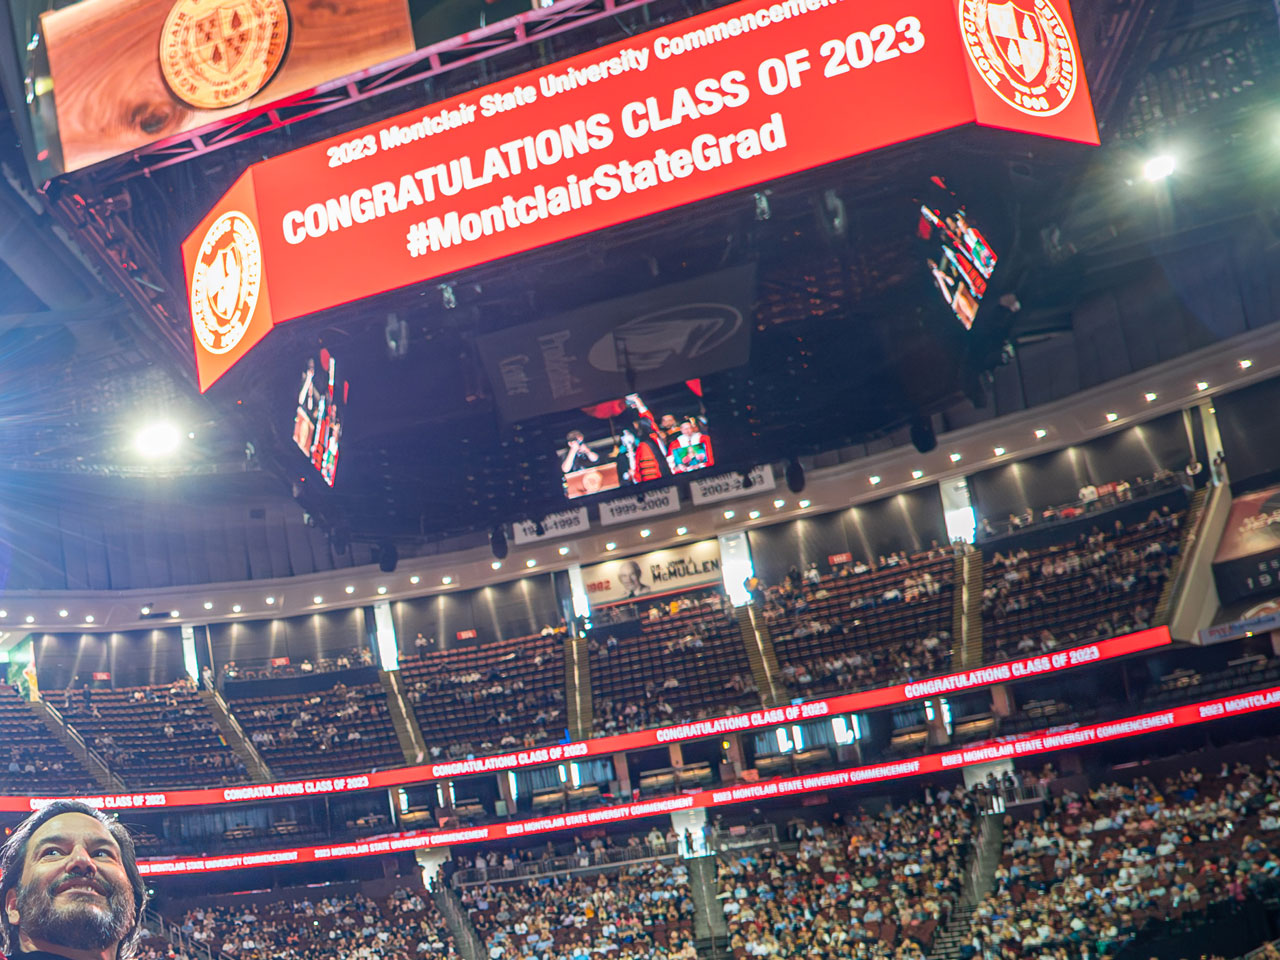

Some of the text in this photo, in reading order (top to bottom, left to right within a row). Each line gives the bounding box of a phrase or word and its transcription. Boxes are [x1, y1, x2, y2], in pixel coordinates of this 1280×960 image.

[327, 135, 377, 168] 2023
[380, 103, 476, 150] Montclair
[480, 86, 537, 117] State
[539, 48, 649, 97] University
[283, 16, 925, 244] CONGRATULATIONS CLASS OF 2023
[407, 112, 787, 257] #MontclairStateGrad
[904, 645, 1100, 699] CONGRATULATIONS CLASS OF 2023
[656, 701, 829, 742] CONGRATULATIONS CLASS OF 2023
[1199, 702, 1225, 718] 2023
[432, 742, 588, 778] CONGRATULATIONS CLASS OF 2023
[941, 712, 1174, 767] 2023 MONTCLAIR STATE UNIVERSITY COMMENCEMENT
[223, 775, 370, 801] CONGRATULATIONS CLASS OF 2023
[712, 760, 920, 803] 2023 MONTCLAIR STATE UNIVERSITY COMMENCEMENT
[505, 796, 694, 835] 2023 MONTCLAIR STATE UNIVERSITY COMMENCEMENT
